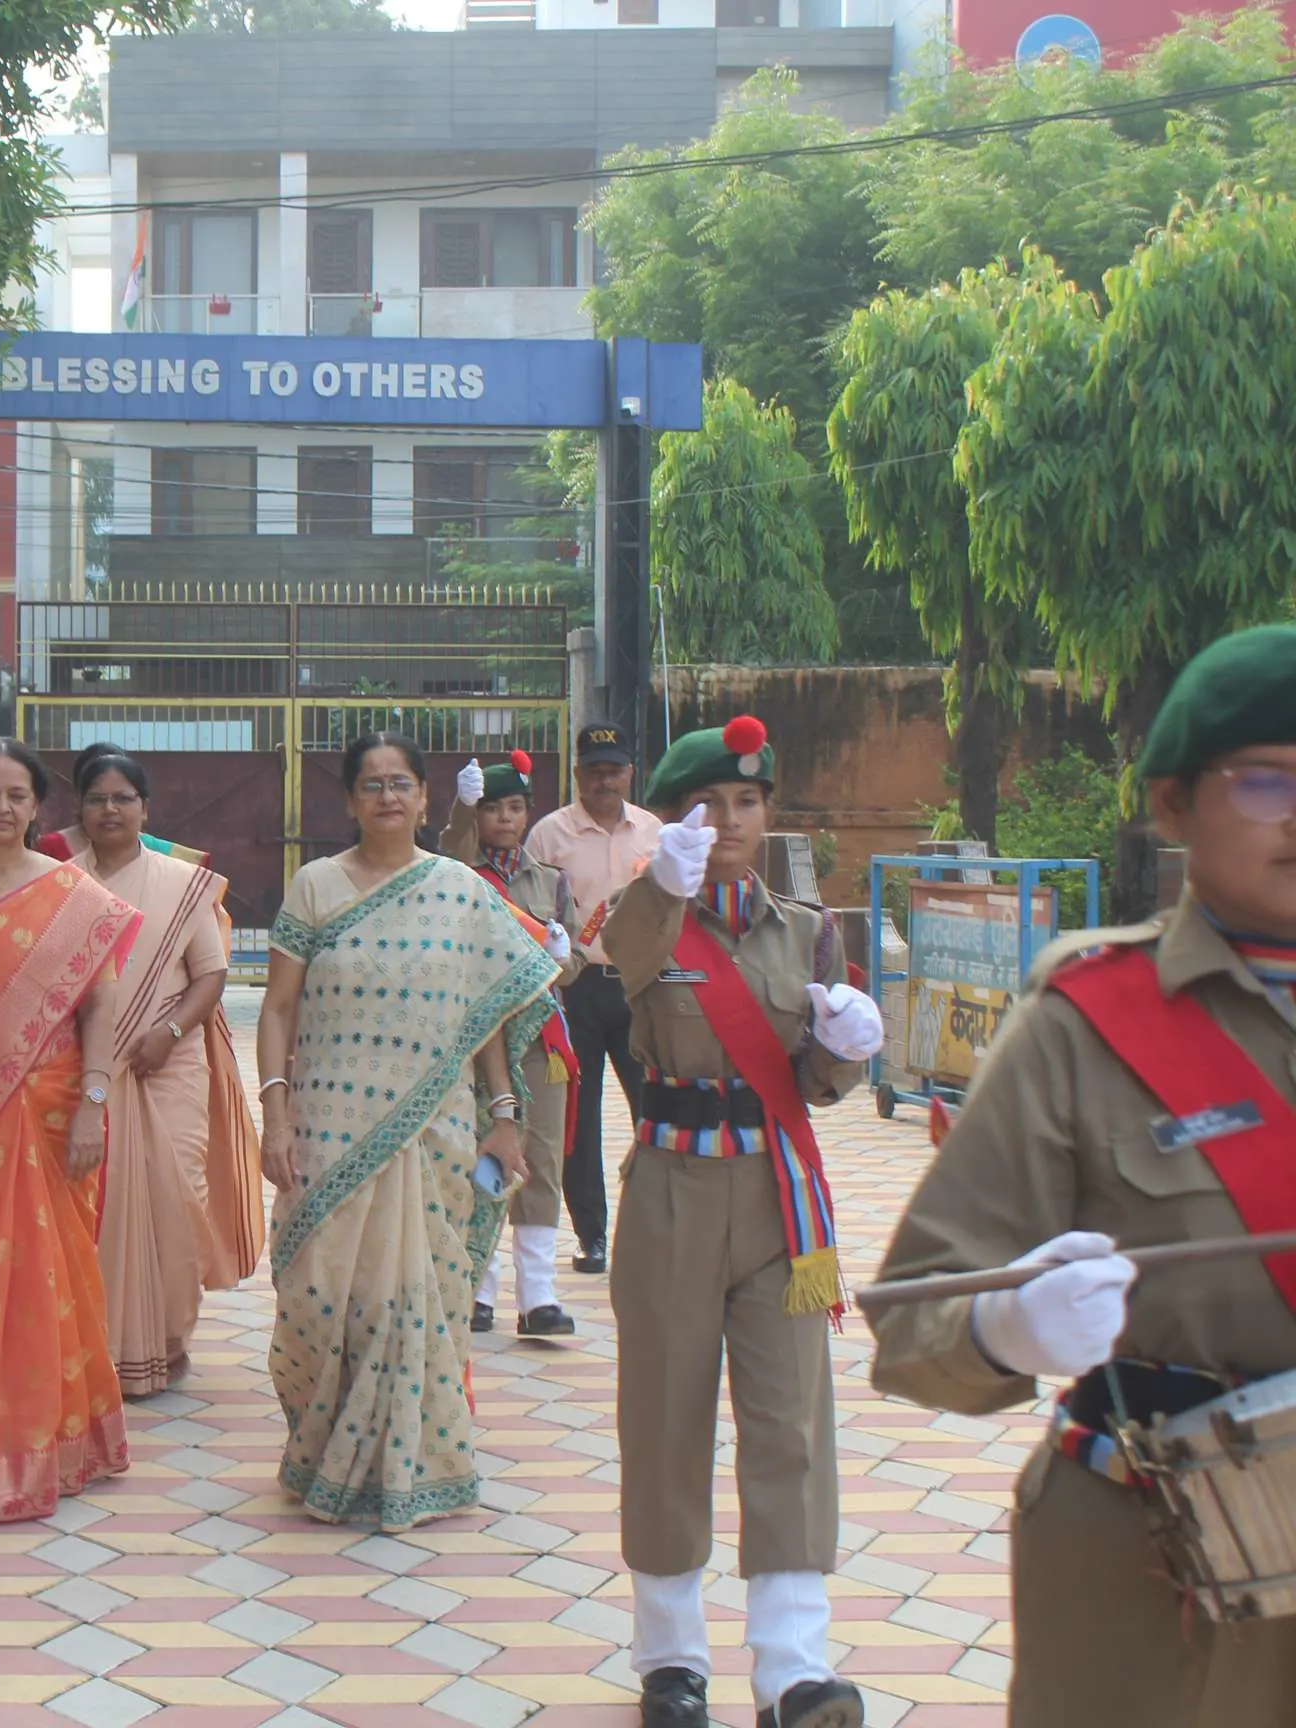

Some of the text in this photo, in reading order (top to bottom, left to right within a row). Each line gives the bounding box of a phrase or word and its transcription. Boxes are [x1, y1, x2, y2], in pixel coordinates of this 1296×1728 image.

[1, 356, 220, 394] BLESSING
[242, 360, 298, 396] TO
[312, 361, 484, 400] OTHERS
